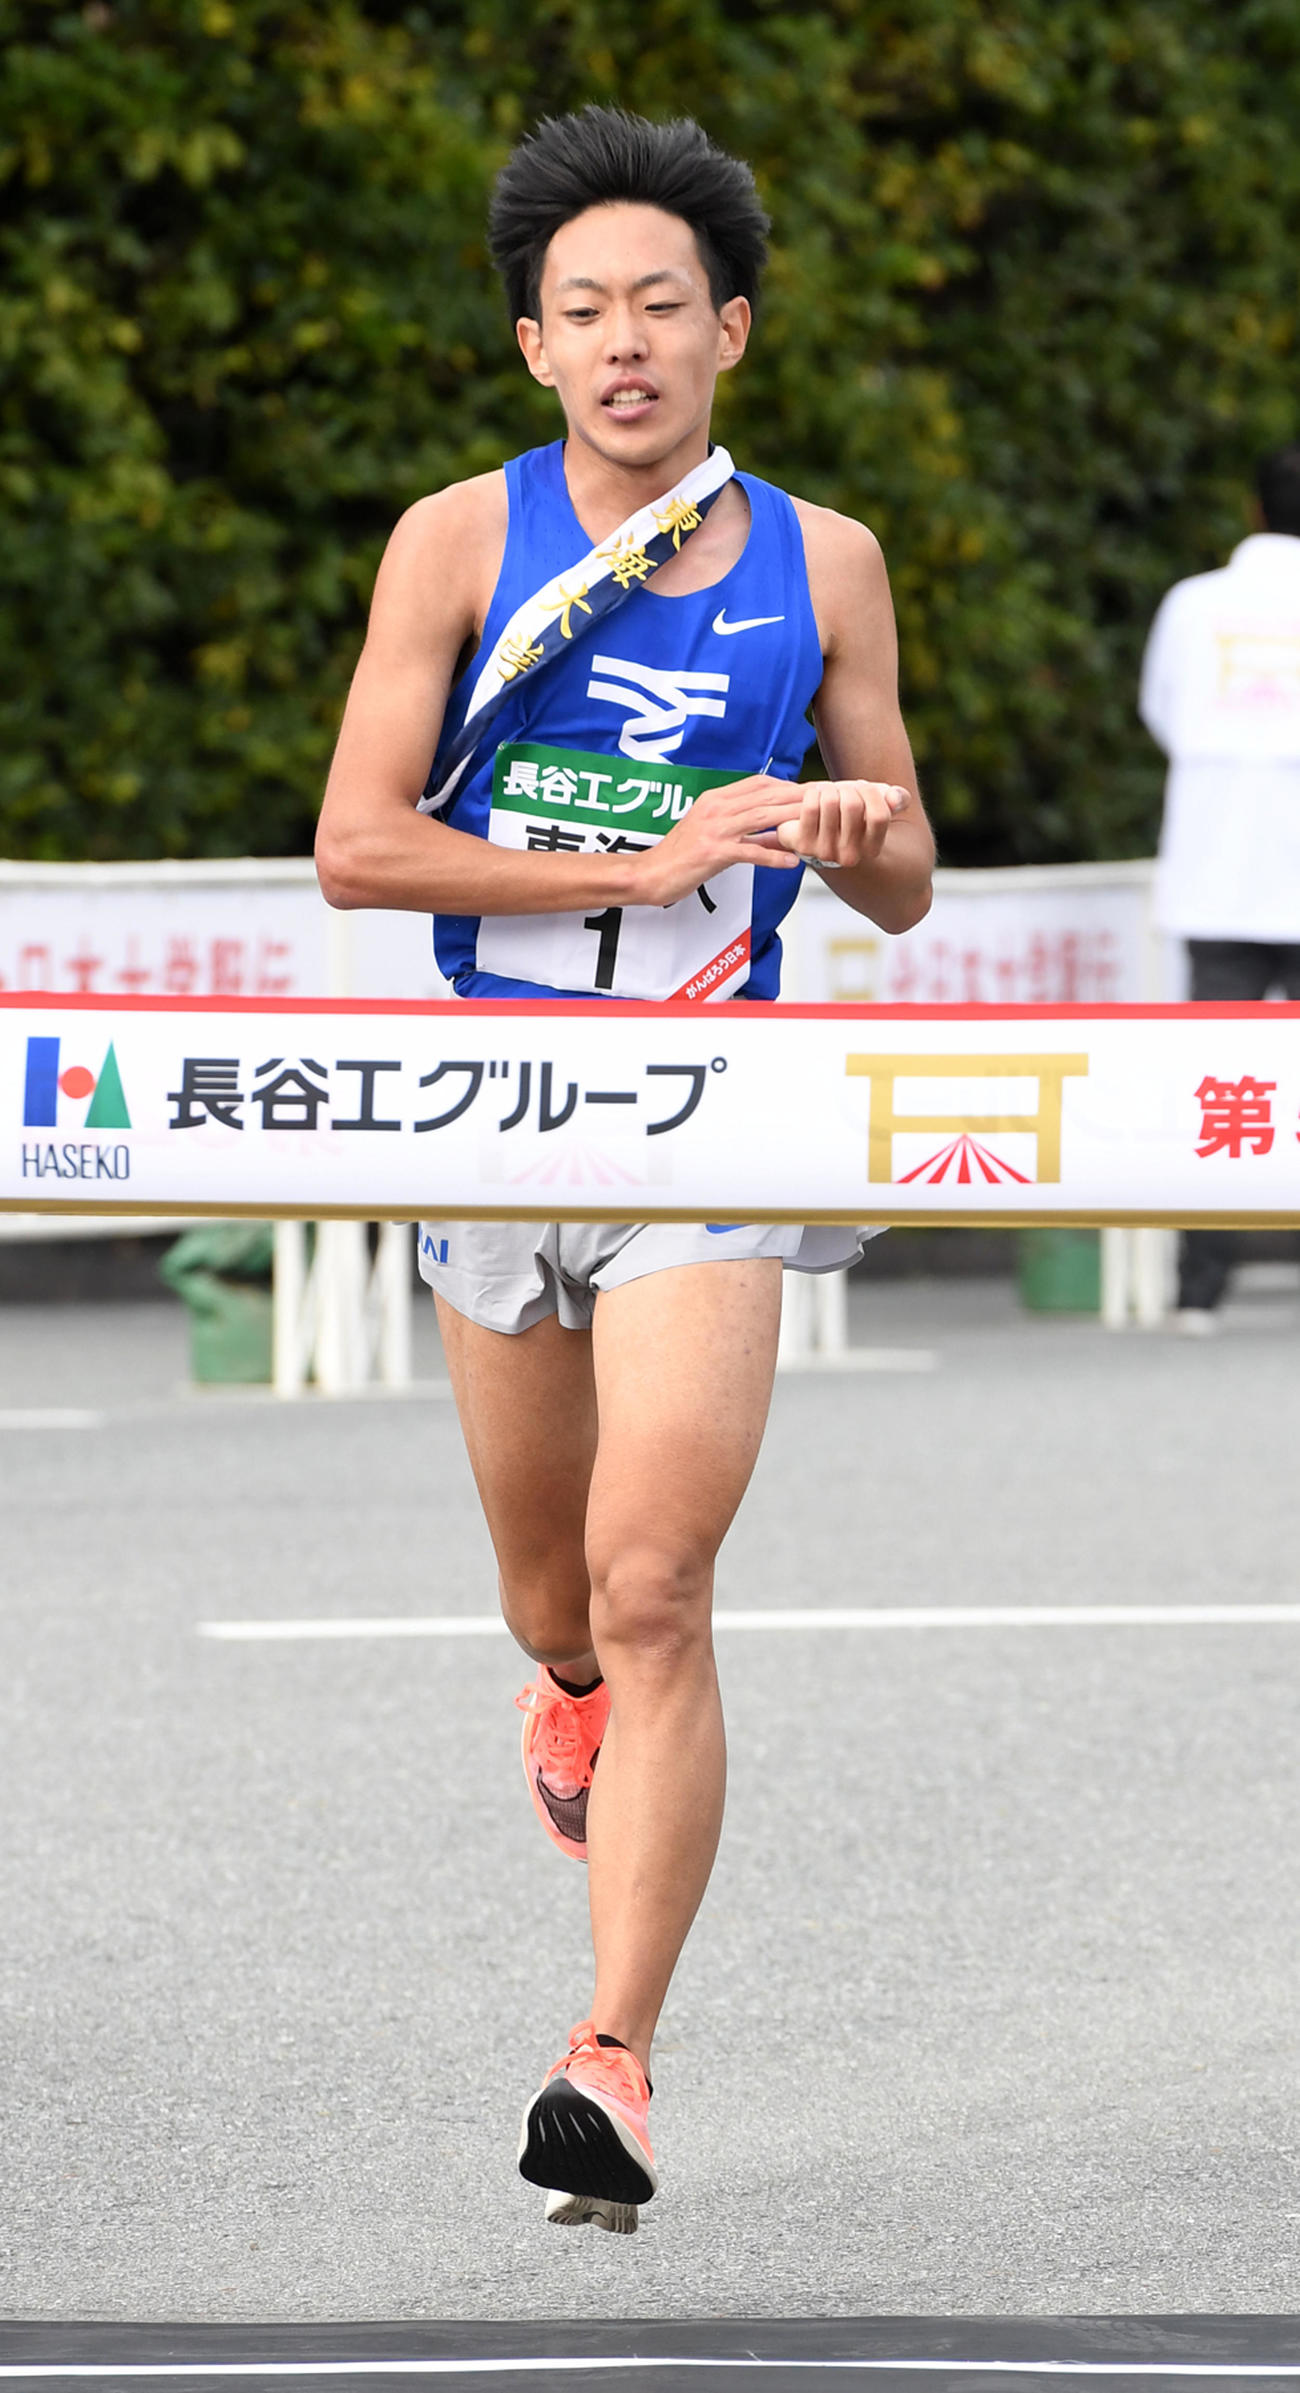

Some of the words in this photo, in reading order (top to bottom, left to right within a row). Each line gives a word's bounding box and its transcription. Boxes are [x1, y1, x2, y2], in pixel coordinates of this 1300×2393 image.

[503, 761, 694, 821] 長谷工グル
[584, 907, 624, 990] 1
[685, 943, 746, 1000] がんばろう日本
[167, 1056, 728, 1136] 長谷工グループ
[1194, 1075, 1300, 1158] 第
[22, 1143, 131, 1180] HASEKO
